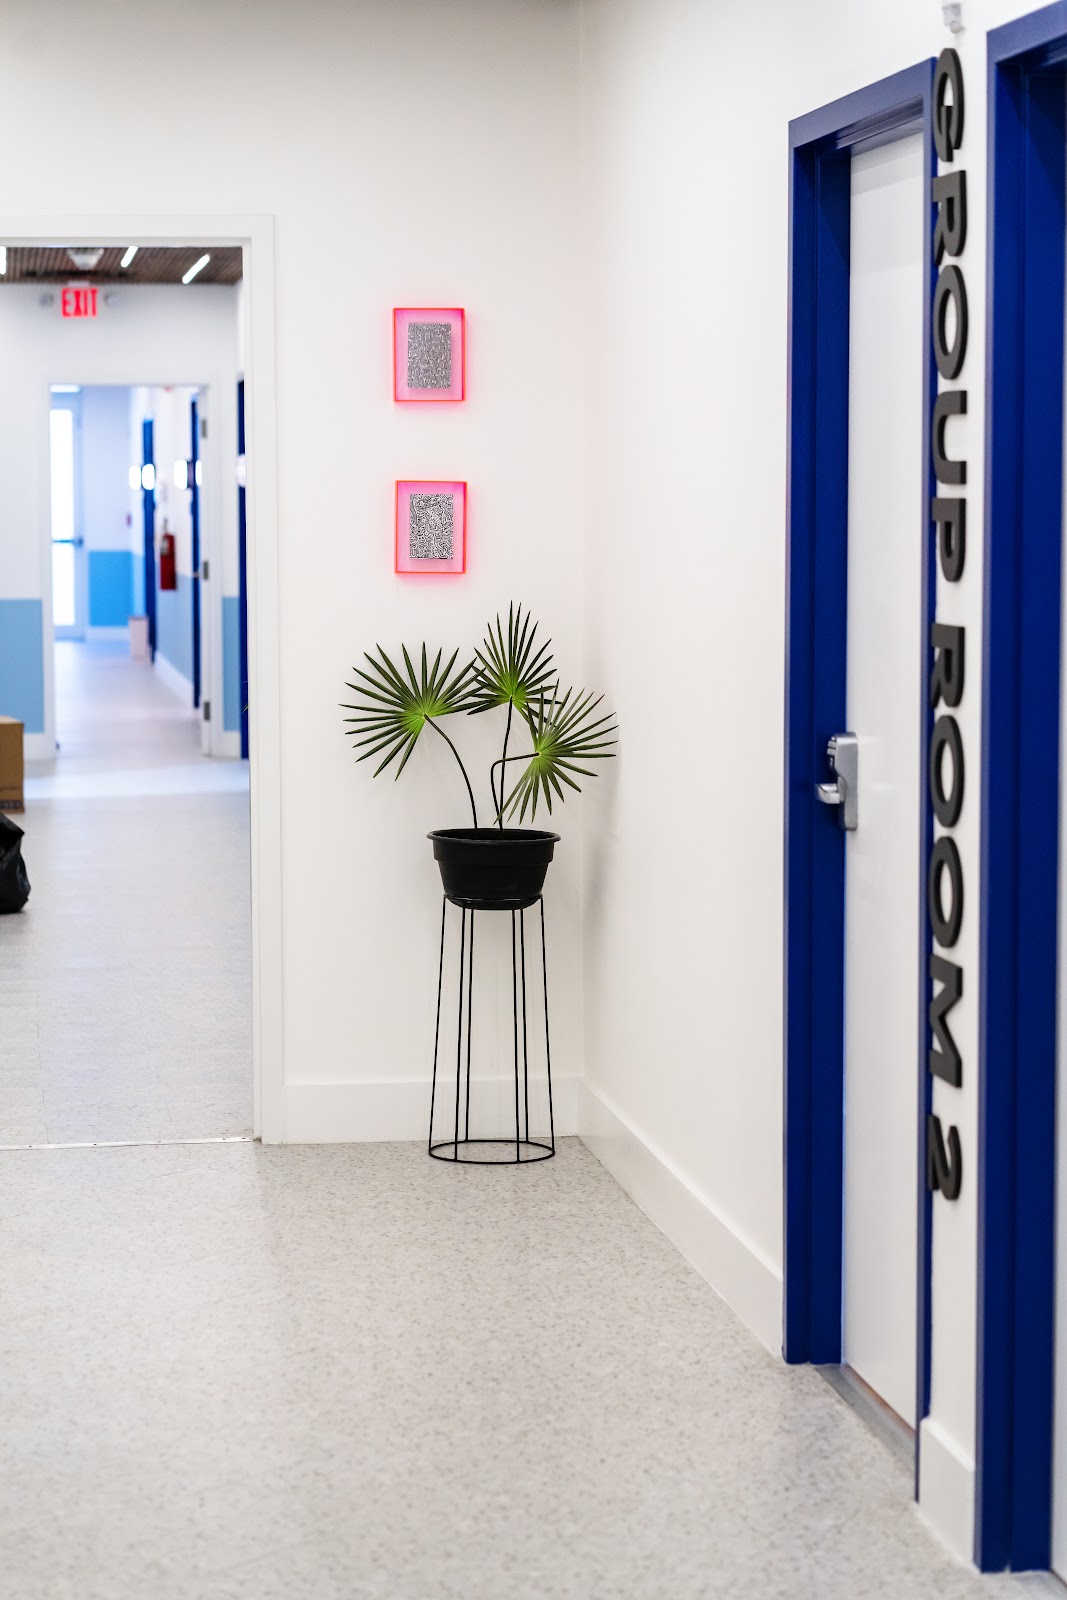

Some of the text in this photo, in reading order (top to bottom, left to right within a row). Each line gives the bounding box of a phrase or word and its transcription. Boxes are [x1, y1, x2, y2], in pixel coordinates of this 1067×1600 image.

[62, 288, 98, 318] EXIT
[928, 47, 968, 1201] GROUP ROOM 2
